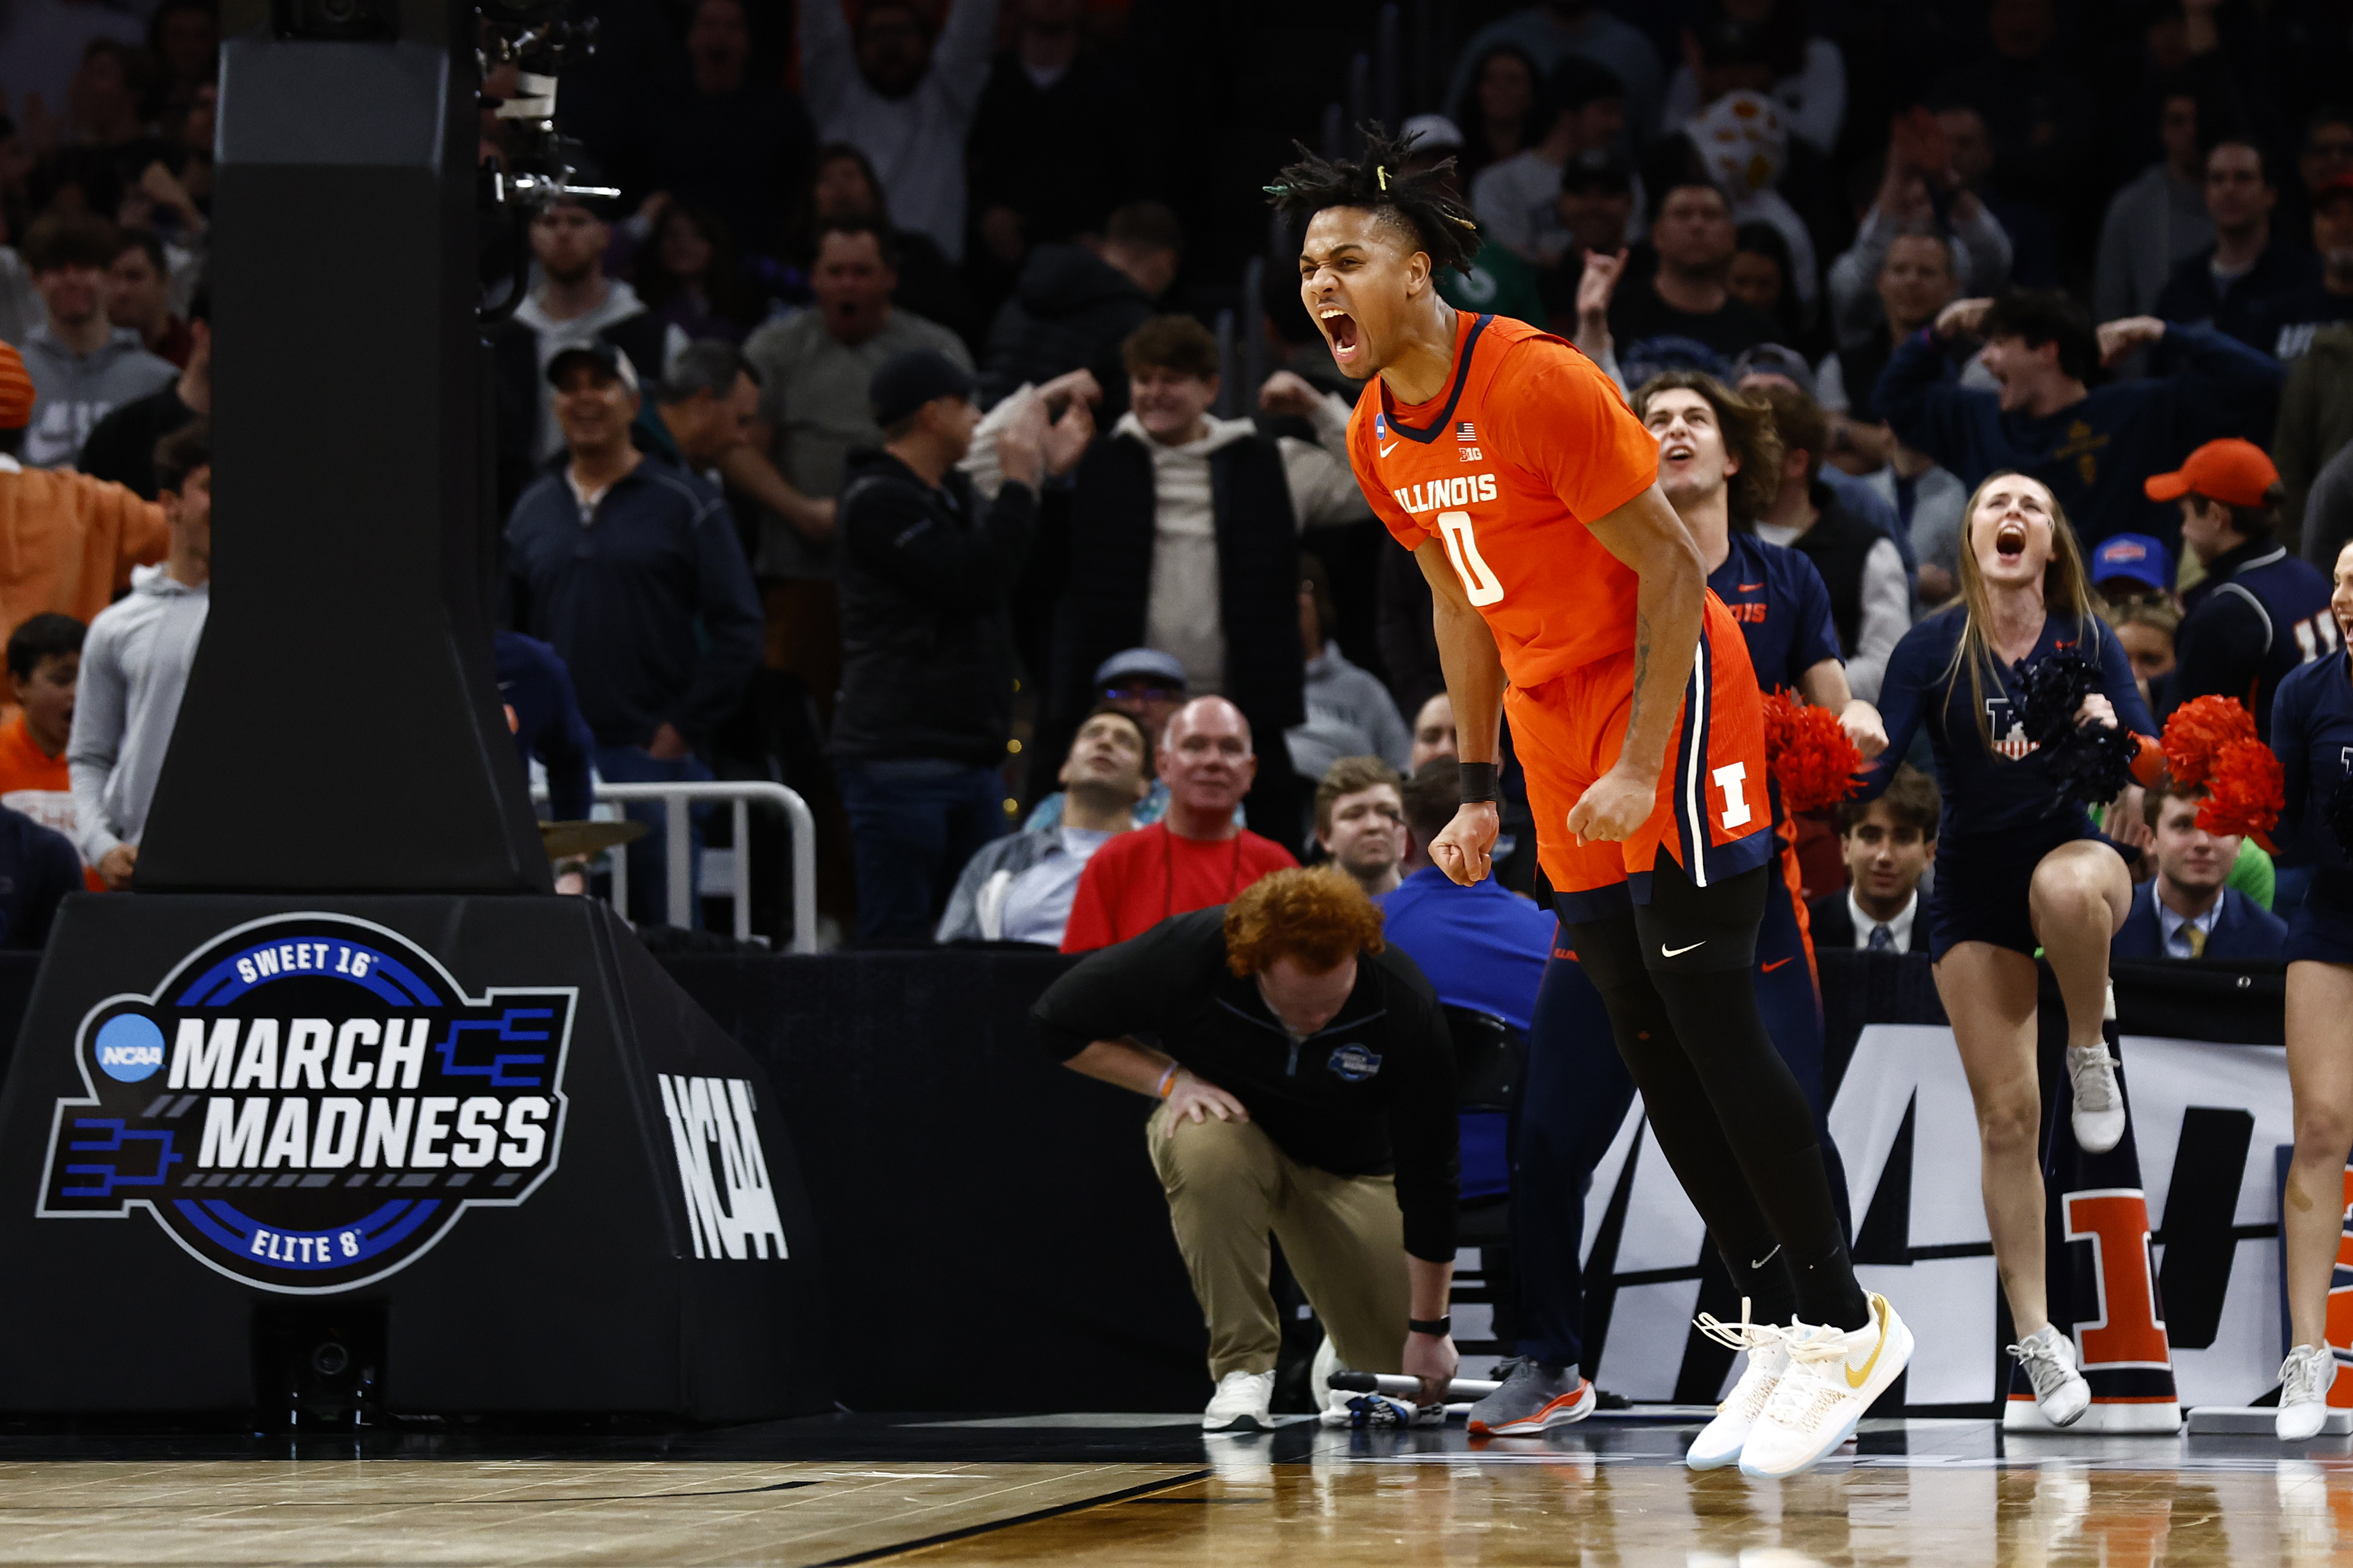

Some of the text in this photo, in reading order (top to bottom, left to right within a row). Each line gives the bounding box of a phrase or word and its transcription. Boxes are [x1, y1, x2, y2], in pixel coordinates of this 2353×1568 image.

[1394, 474, 1497, 514] ILLINOIS
[1437, 511, 1505, 607] 0
[1712, 761, 1752, 830] I
[236, 943, 372, 984] SWEET 16
[102, 1046, 163, 1065] NCAA
[166, 1018, 431, 1090] MARCH
[197, 1096, 551, 1168] MADNESS
[658, 1073, 790, 1260] NCAA
[250, 1229, 359, 1263] ELITE 8
[2062, 1187, 2172, 1372] I
